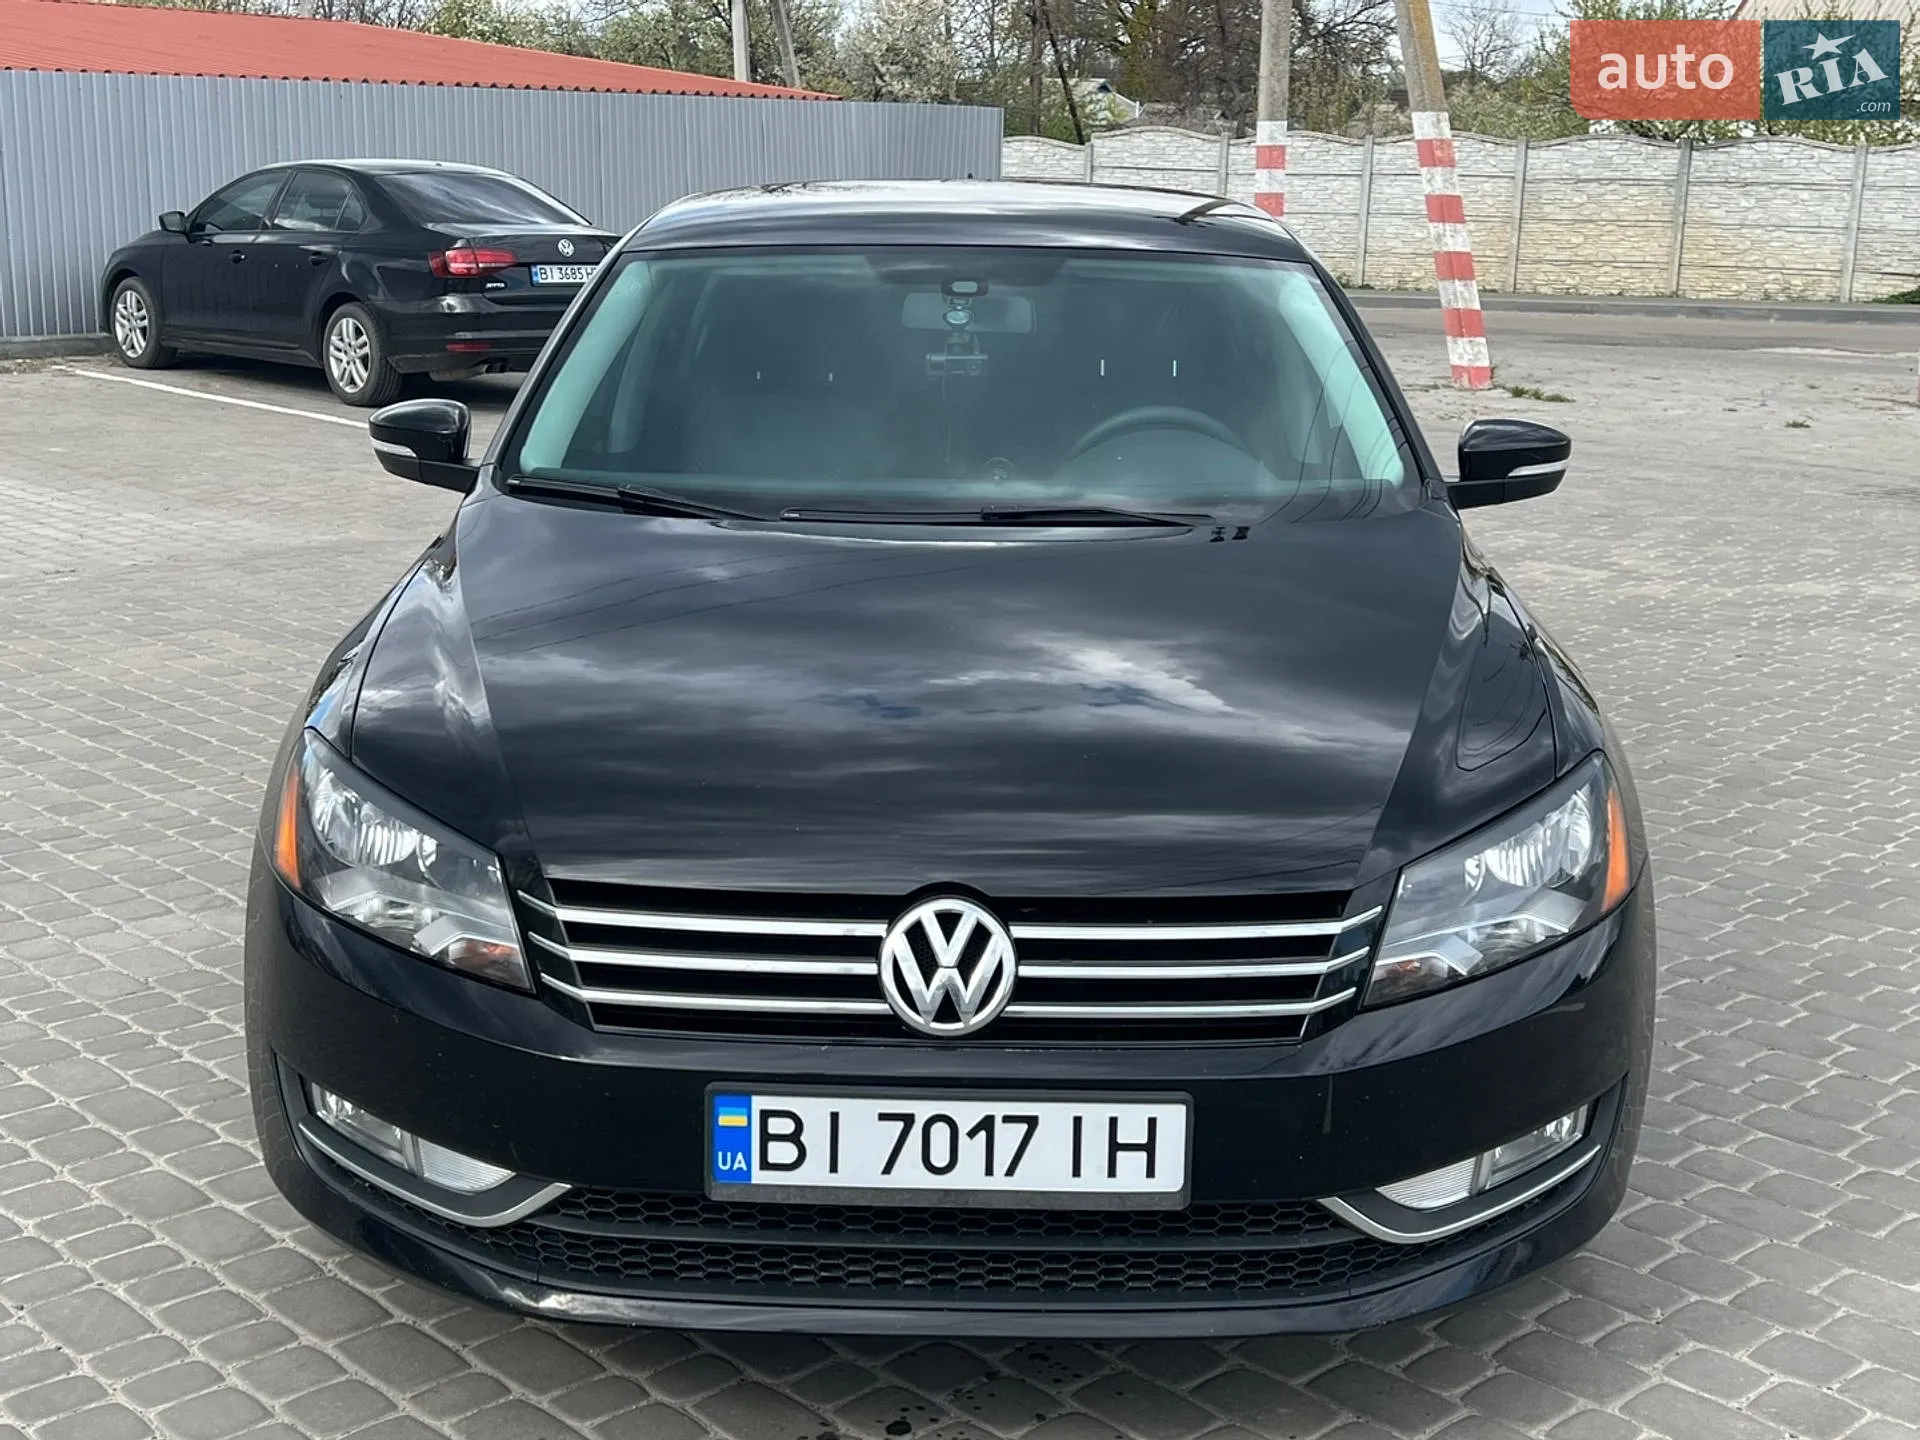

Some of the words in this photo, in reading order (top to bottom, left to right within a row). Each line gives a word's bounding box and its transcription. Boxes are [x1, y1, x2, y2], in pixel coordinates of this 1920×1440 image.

[539, 267, 554, 280] BI
[557, 267, 584, 280] 3685
[585, 267, 597, 280] H
[759, 1109, 840, 1174] BI
[877, 1112, 1040, 1177] 7017
[1071, 1115, 1158, 1179] IH
[718, 1151, 747, 1171] UA
